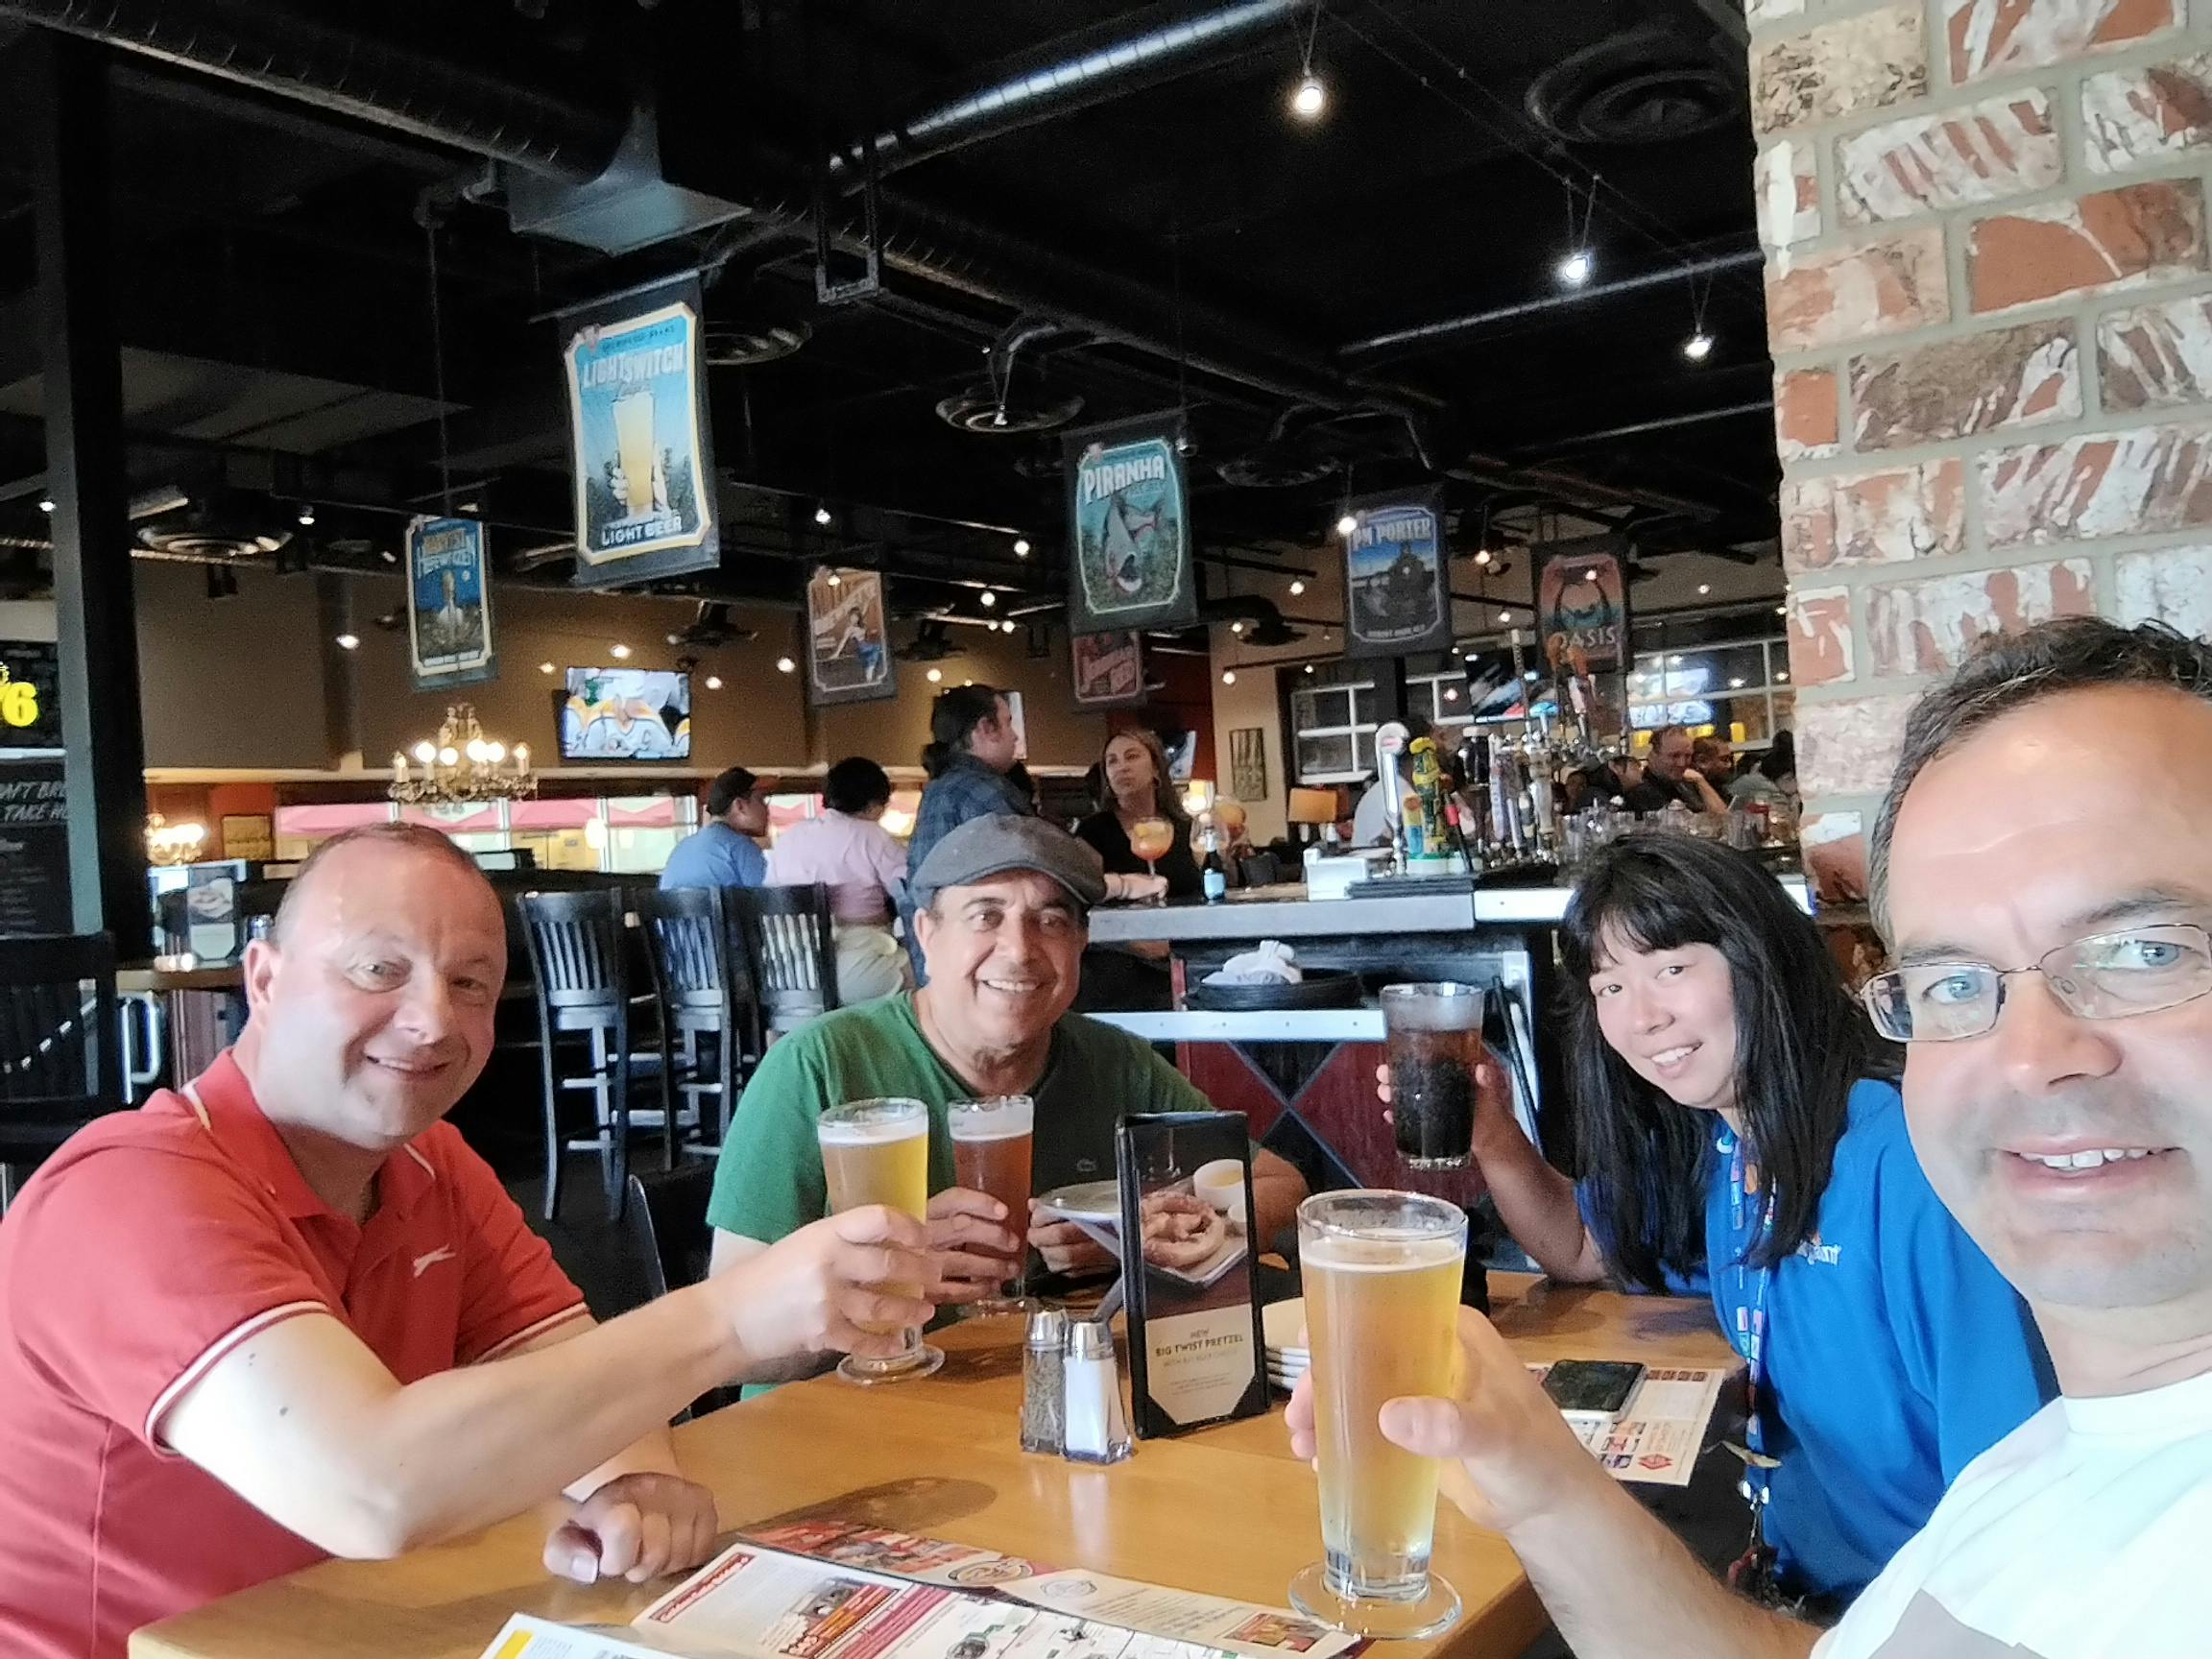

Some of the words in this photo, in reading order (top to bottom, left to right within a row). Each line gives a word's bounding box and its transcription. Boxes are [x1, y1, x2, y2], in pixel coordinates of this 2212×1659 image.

[582, 343, 685, 388] LIGHTSWITCH
[1084, 455, 1165, 504] PIRANHA
[602, 524, 644, 546] LIGHT
[644, 516, 683, 539] BEER
[1155, 1346, 1172, 1357] BIG
[1174, 1339, 1203, 1354] TWIST
[1205, 1334, 1243, 1348] PRETZEL
